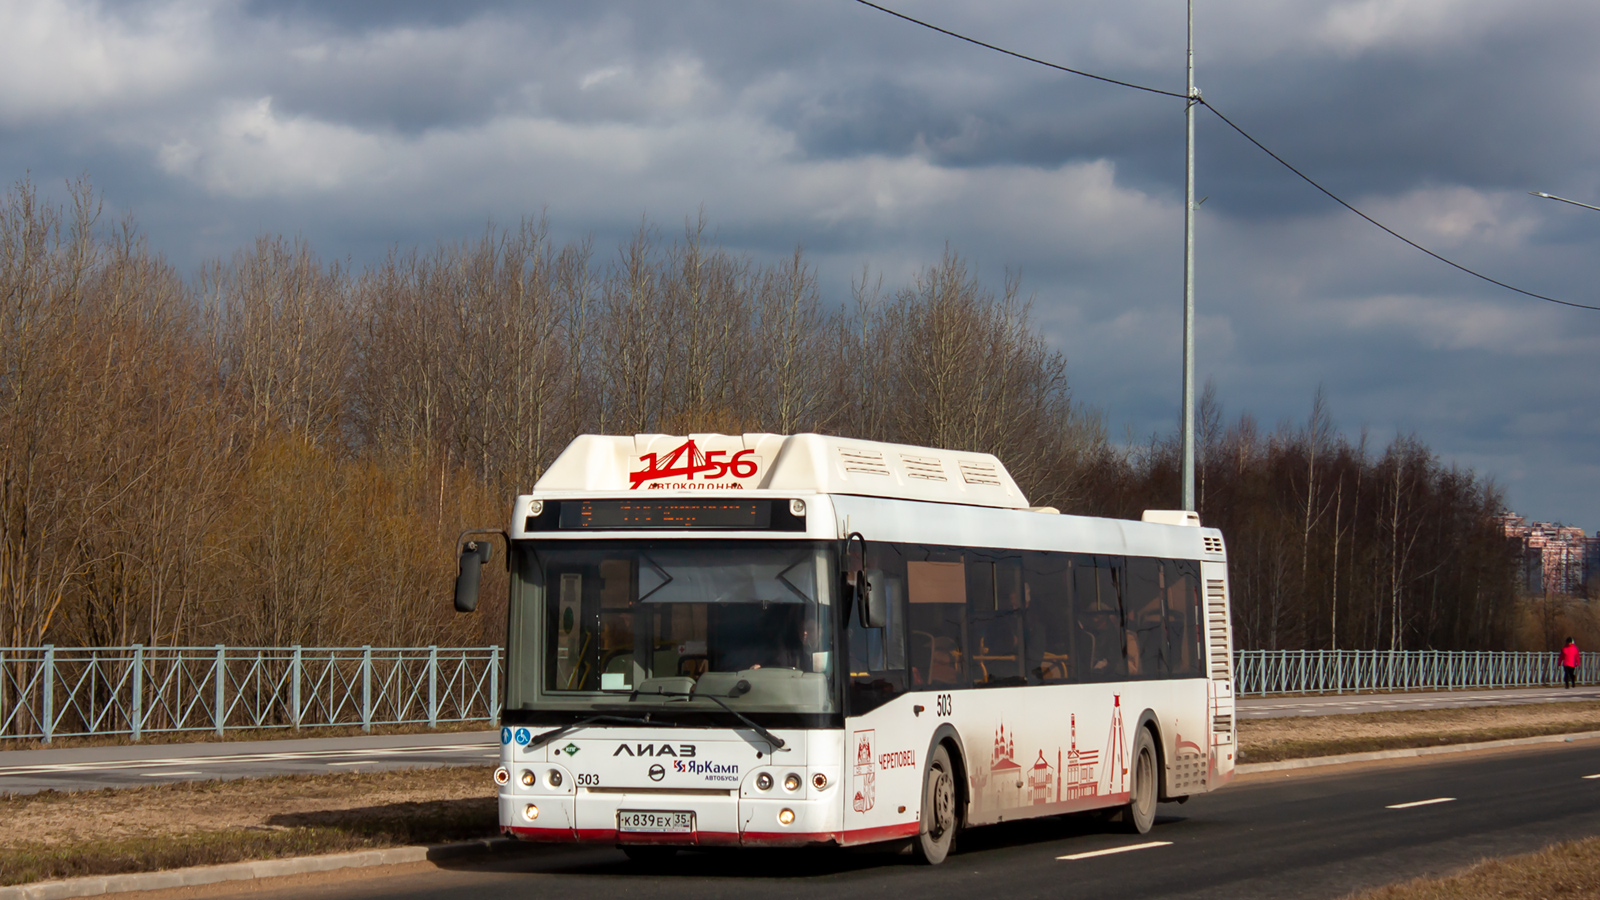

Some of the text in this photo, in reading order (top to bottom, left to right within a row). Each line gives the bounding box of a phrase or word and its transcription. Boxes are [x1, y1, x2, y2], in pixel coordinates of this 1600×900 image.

[632, 439, 758, 482] 1456
[937, 693, 952, 717] 503
[612, 743, 697, 757] ЛИАЗ
[878, 749, 916, 770] ЧЕРЕПОВЕЦ
[688, 760, 739, 775] ЯрКамп
[577, 774, 600, 785] 503
[675, 814, 687, 824] 35
